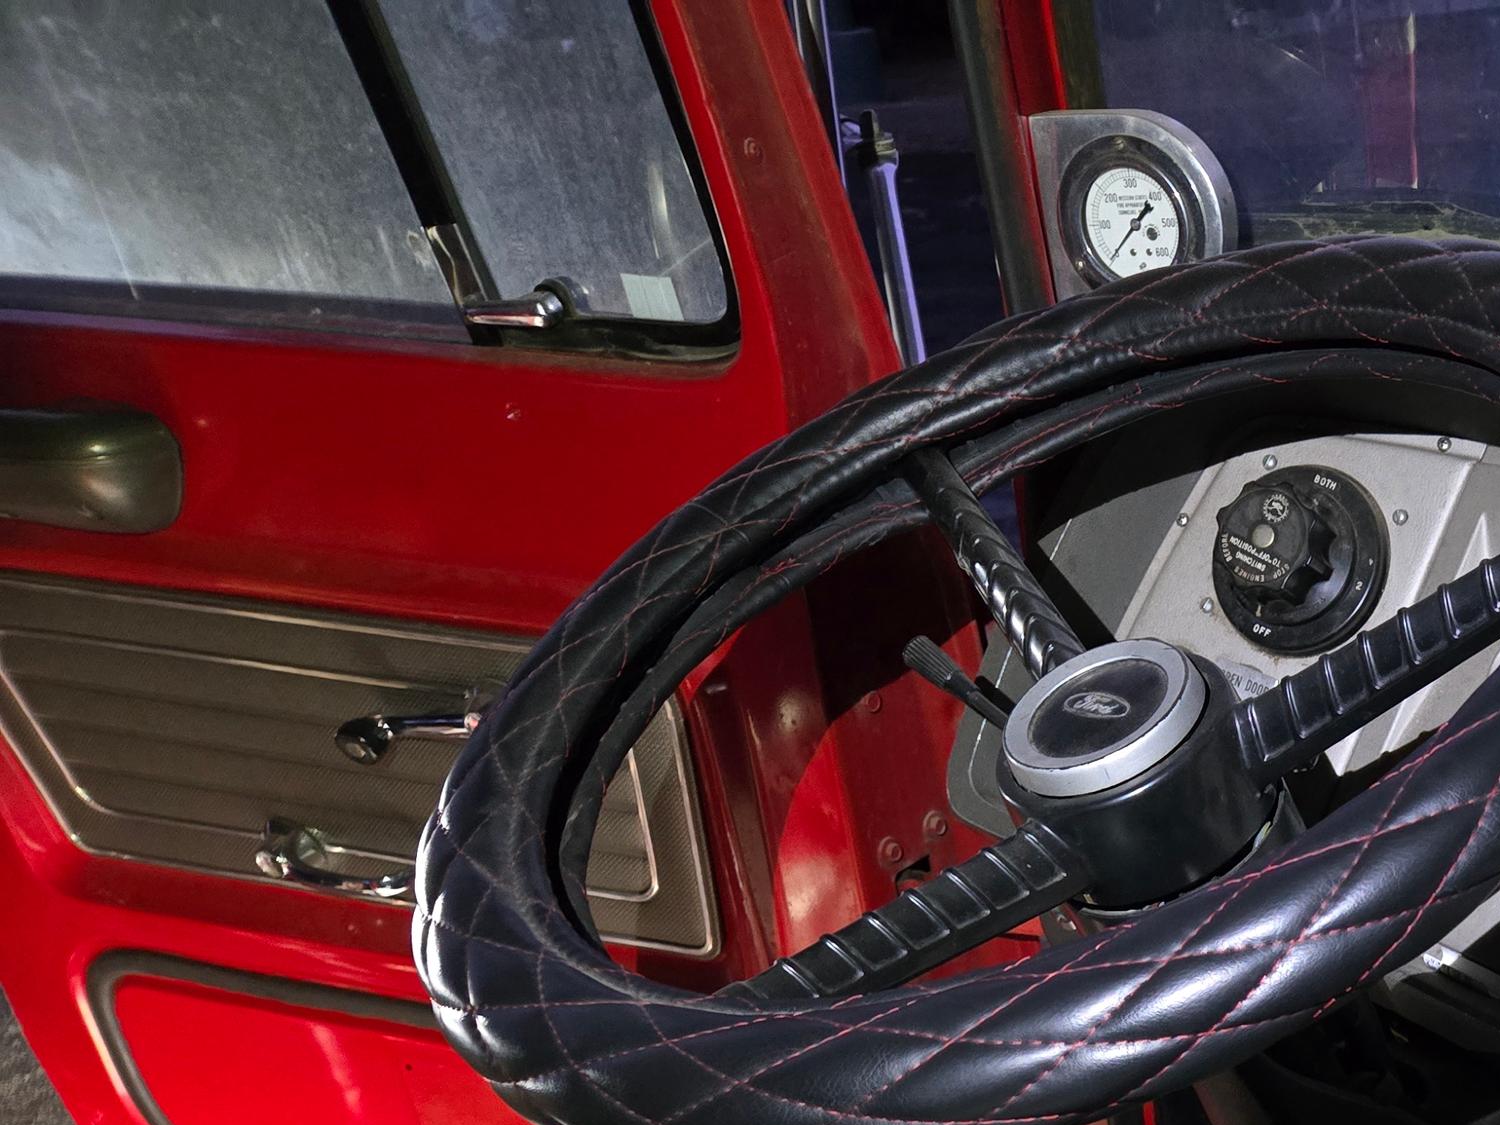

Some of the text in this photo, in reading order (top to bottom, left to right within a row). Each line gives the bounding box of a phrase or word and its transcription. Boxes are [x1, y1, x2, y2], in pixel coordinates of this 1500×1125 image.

[1123, 178, 1137, 188] 300
[1104, 193, 1118, 203] 200
[1148, 191, 1162, 201] 400
[1161, 218, 1176, 228] 500
[1155, 247, 1169, 257] 600
[1314, 474, 1337, 491] BOTH
[1230, 536, 1257, 554] POSITION
[1235, 551, 1267, 572] SWITCHING
[1272, 557, 1281, 568] TO
[1234, 565, 1265, 583] ENGINES
[1355, 581, 1363, 591] 2
[1252, 623, 1272, 638] OFF
